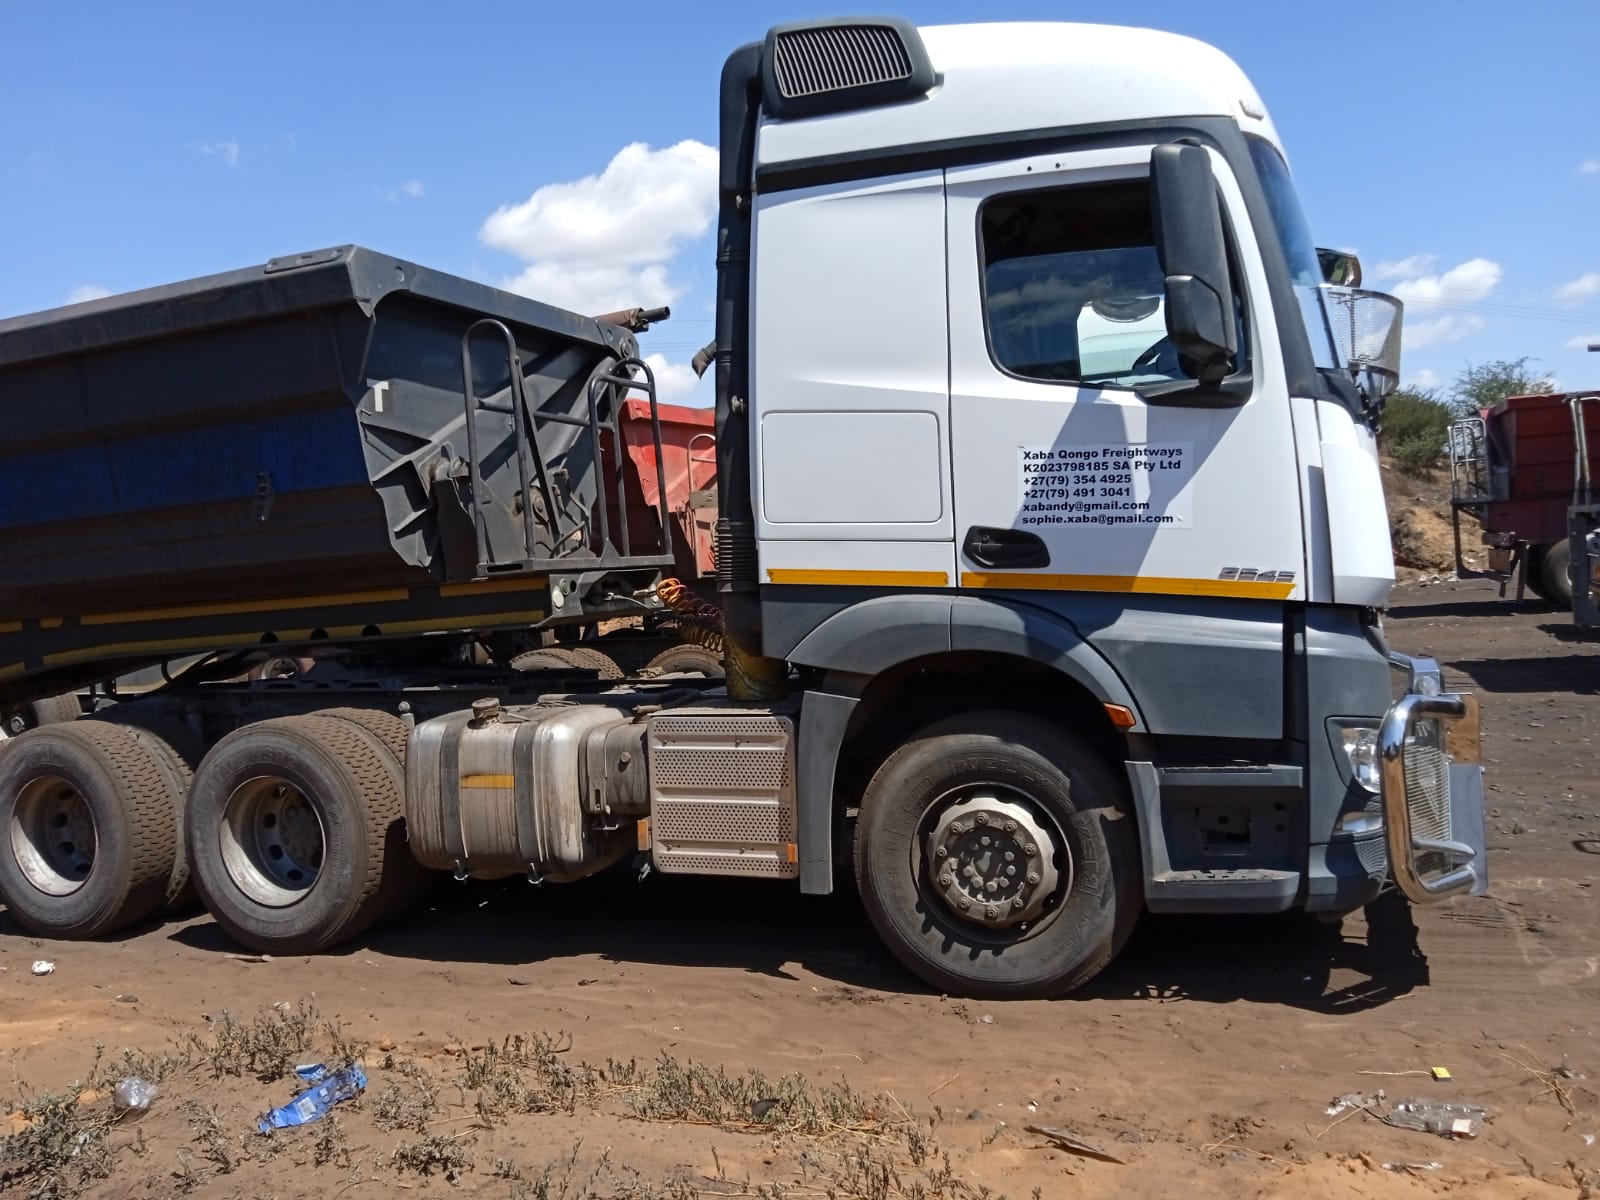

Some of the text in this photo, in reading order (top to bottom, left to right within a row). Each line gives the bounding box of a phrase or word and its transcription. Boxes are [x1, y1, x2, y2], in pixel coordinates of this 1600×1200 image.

[1023, 447, 1183, 461] Xaba Qongo Freightways
[1023, 459, 1182, 473] K2023798185 SA Pty Ltd
[1023, 473, 1132, 488] +27(79) 354 4925
[1023, 487, 1130, 501] +27(79) 491 3041
[1023, 500, 1150, 513] xabandy@gmail.com
[1021, 514, 1174, 526] sophie.xaba@gmail.com
